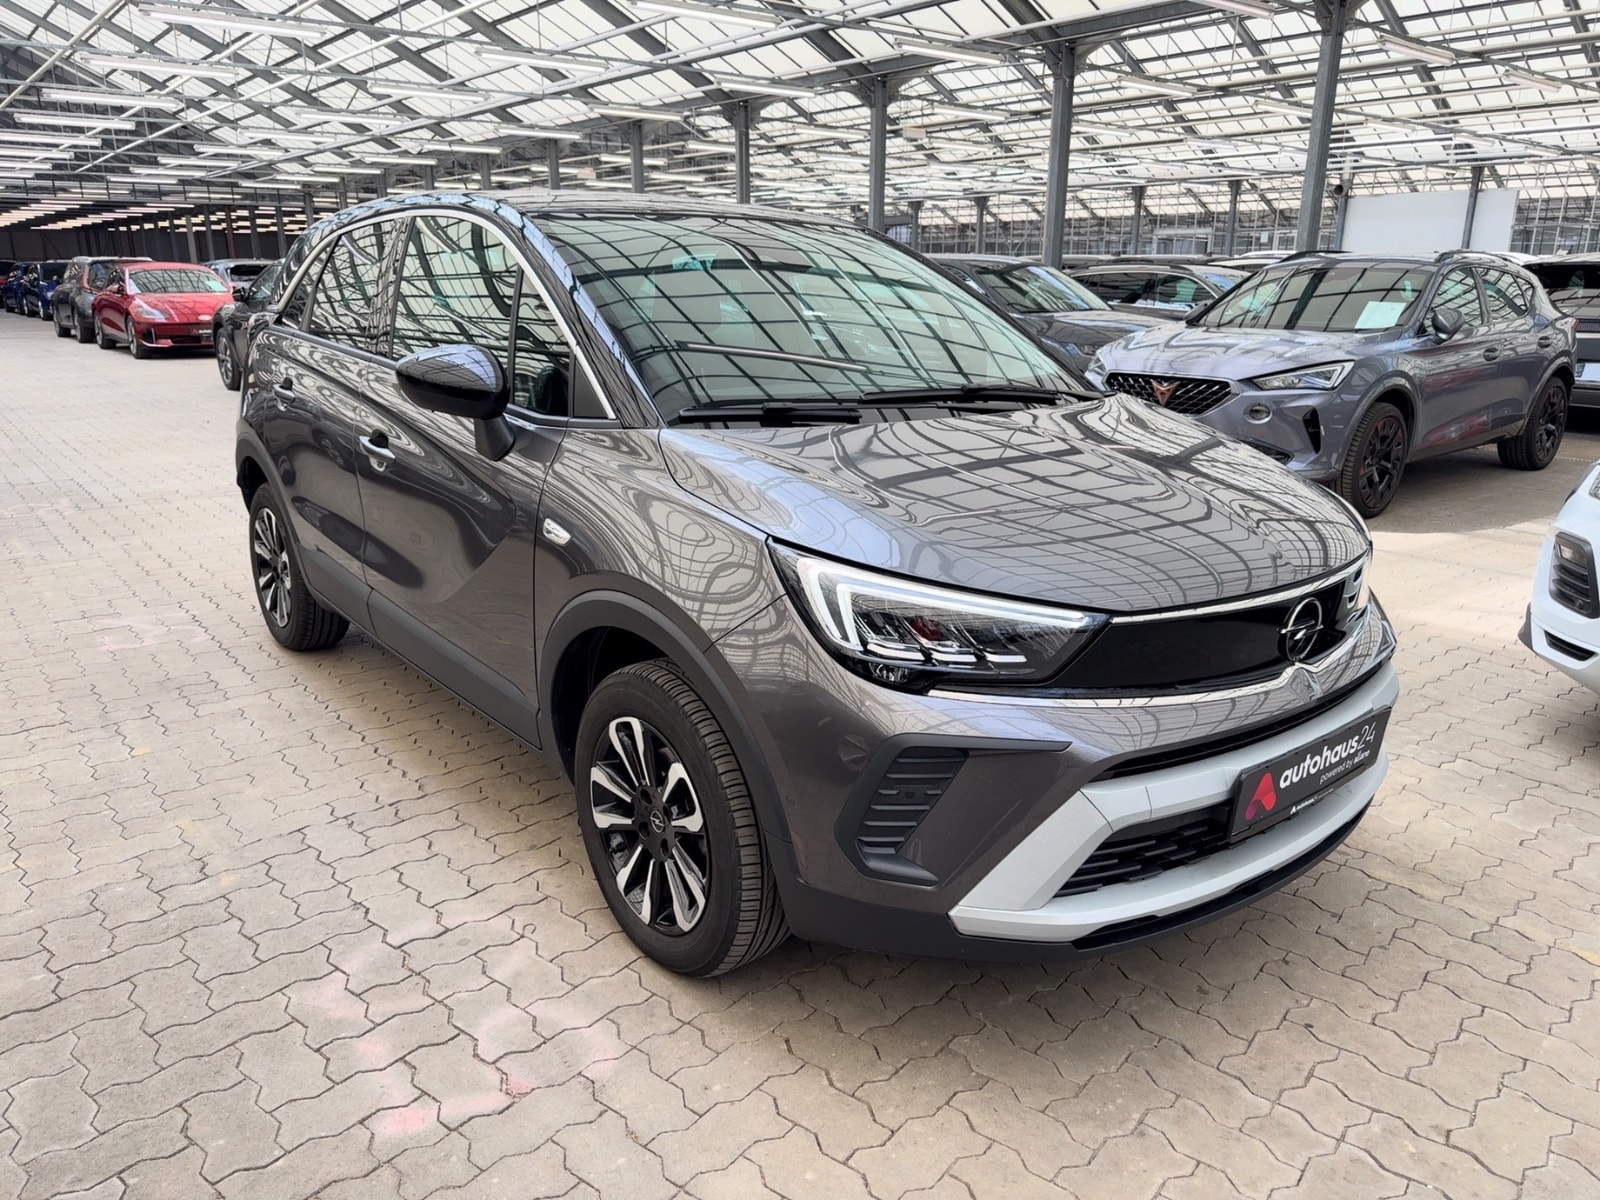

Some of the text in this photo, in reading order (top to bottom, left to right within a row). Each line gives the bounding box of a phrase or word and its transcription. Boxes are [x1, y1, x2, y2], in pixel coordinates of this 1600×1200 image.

[1279, 721, 1377, 789] autohaus24
[1319, 760, 1346, 785] powered
[1345, 758, 1354, 769] by
